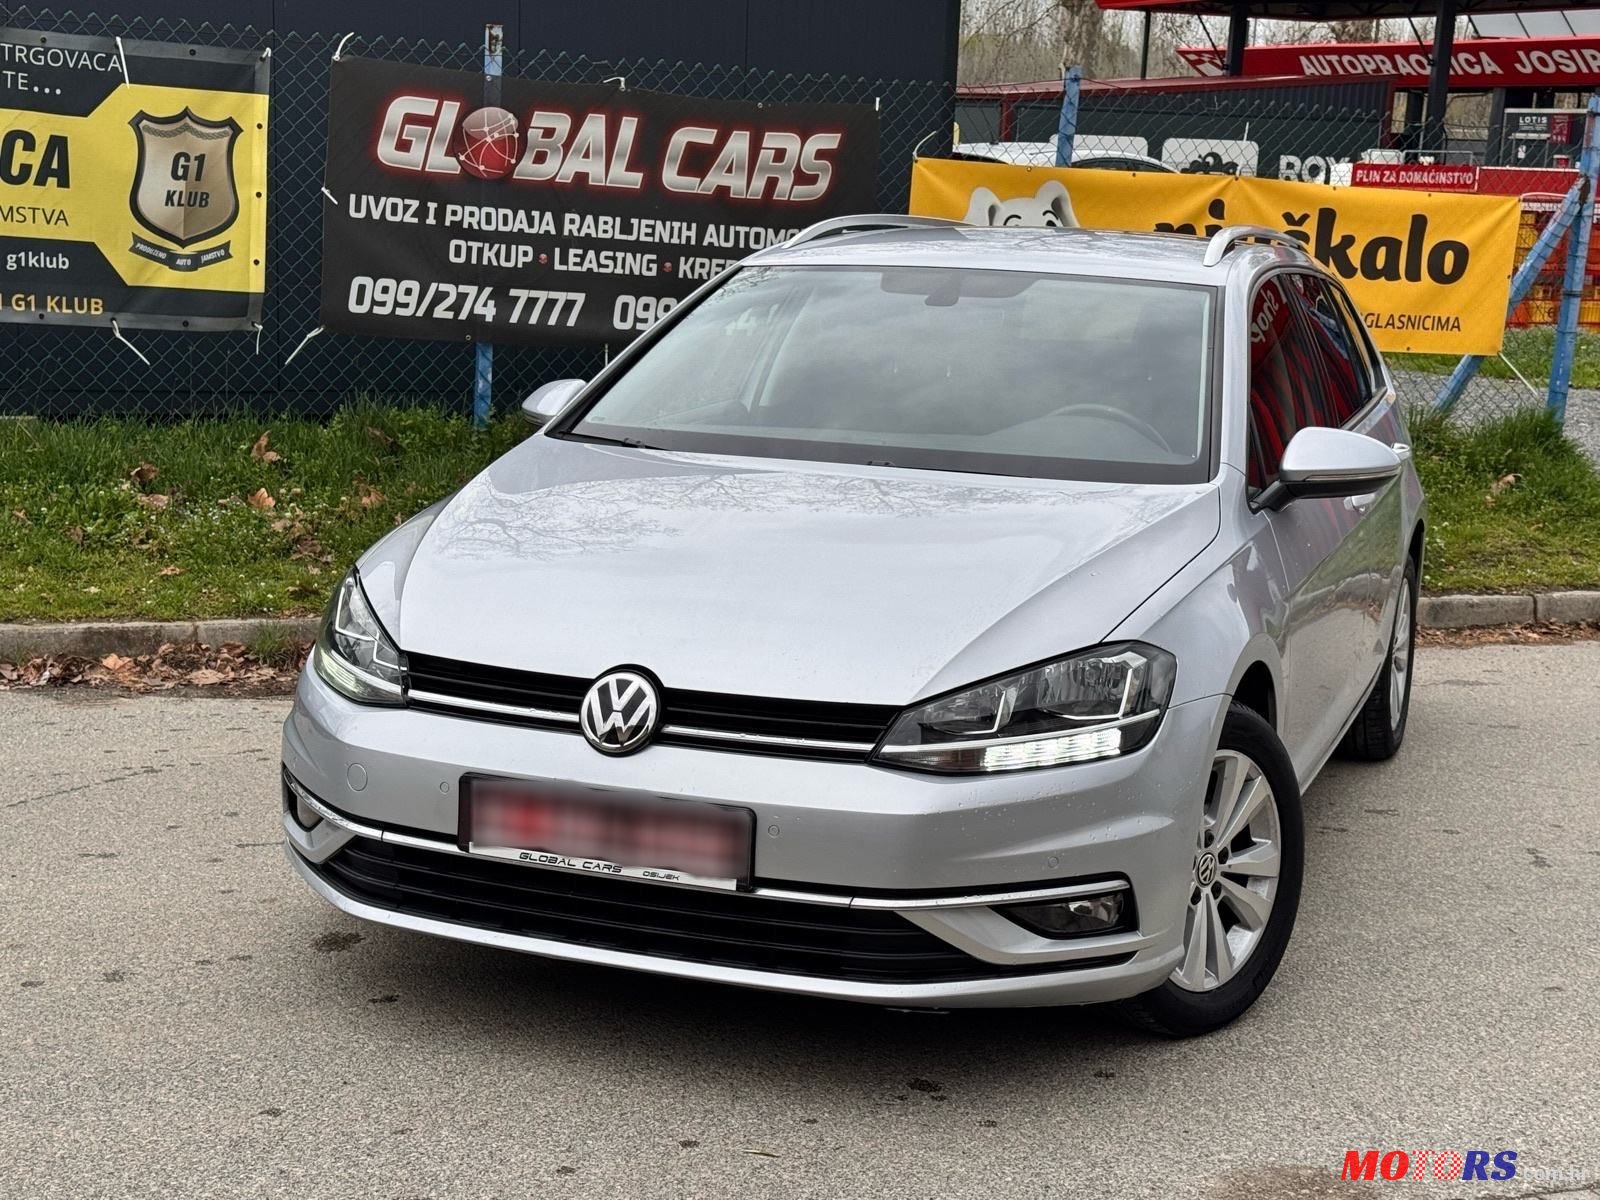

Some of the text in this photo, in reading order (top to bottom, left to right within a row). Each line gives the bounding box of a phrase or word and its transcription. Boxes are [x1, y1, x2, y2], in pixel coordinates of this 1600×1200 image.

[0, 43, 122, 73] TRGOVACA
[1299, 48, 1600, 76] AUTOPRAOICA JOSIP
[1519, 115, 1548, 124] LOTIS
[0, 129, 71, 189] CA
[377, 95, 842, 201] GLOBAL CARS
[170, 151, 206, 182] G1
[1356, 169, 1381, 183] PLIN
[1382, 170, 1396, 183] ZA
[164, 189, 210, 208] KLUB
[348, 193, 419, 223] UVOZ
[425, 202, 438, 225] I
[445, 204, 556, 235] PRODAJA
[563, 213, 697, 246] RABLJENIH
[6, 251, 70, 271] g1klub
[449, 239, 534, 268] OTKUP
[554, 247, 658, 276] LEASING
[11, 293, 36, 312] G1
[46, 295, 104, 315] KLUB
[348, 275, 497, 323] 099/274
[508, 288, 587, 327] 7777
[1360, 312, 1462, 333] GLASNICIMA
[519, 851, 681, 881] GLOBAL CARS OSIJEK
